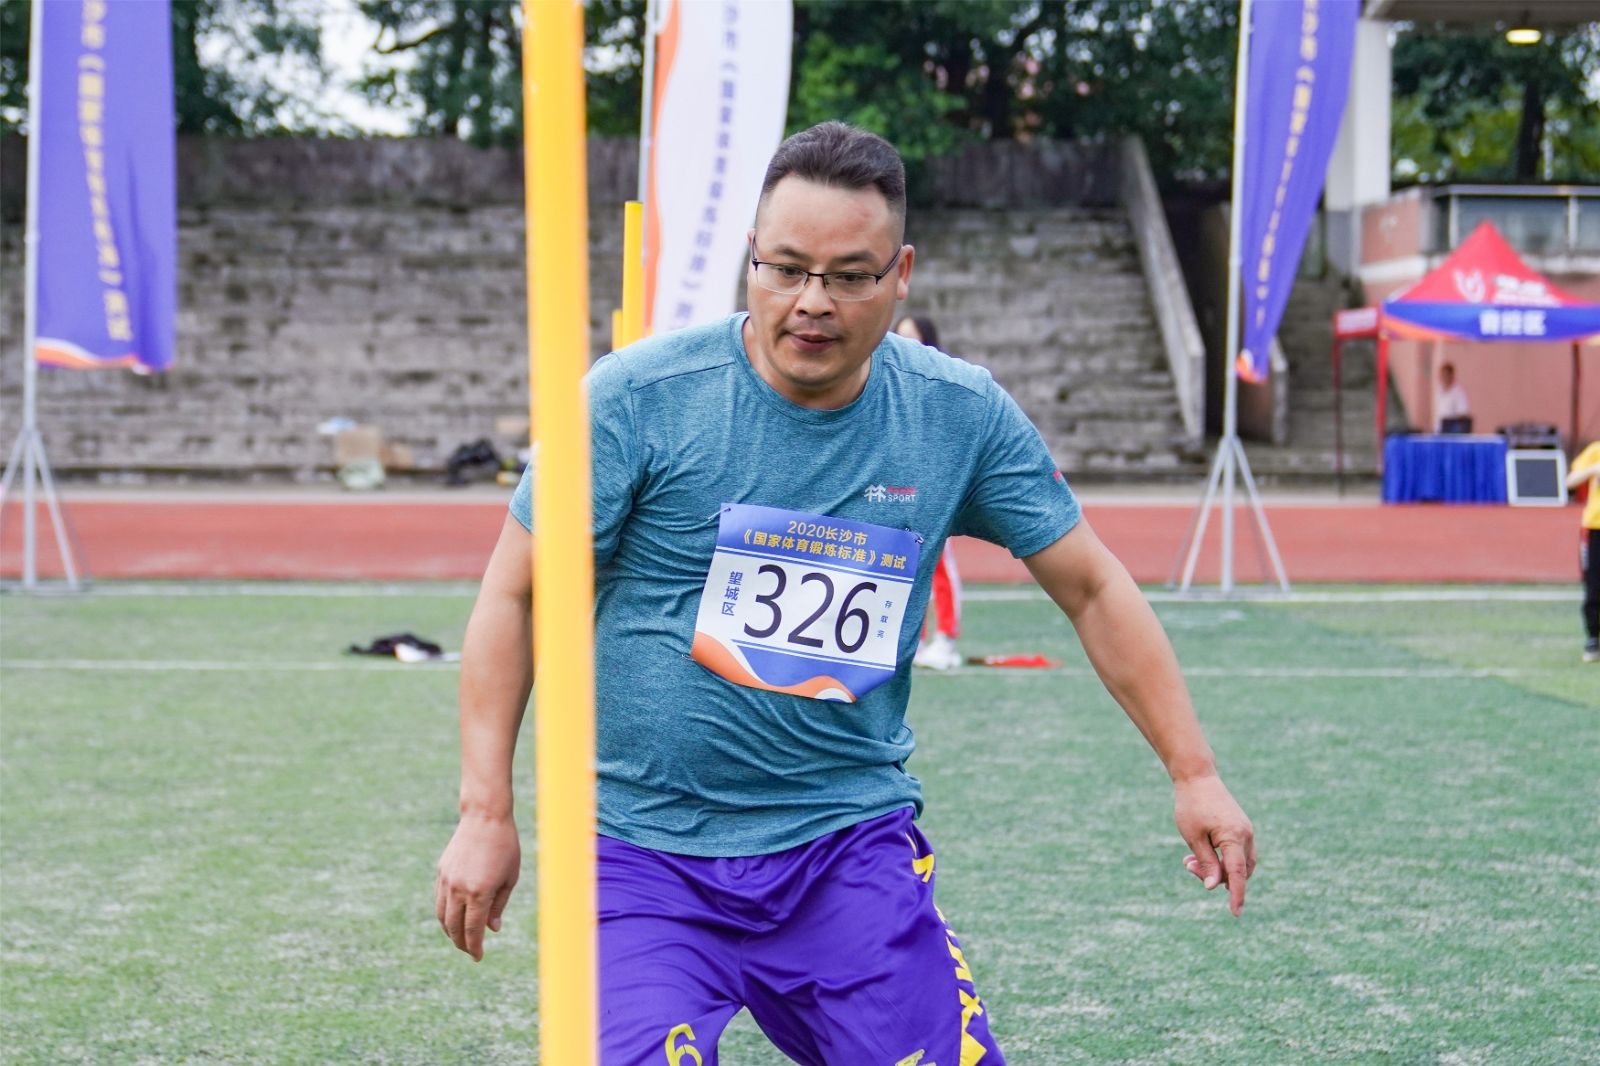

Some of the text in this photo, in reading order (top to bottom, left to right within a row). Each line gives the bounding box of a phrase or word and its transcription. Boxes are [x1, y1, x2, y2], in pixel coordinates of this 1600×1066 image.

[887, 493, 916, 502] SPORT
[787, 520, 868, 546] 2020长沙市
[721, 571, 743, 616] 望城区
[743, 564, 878, 654] 326
